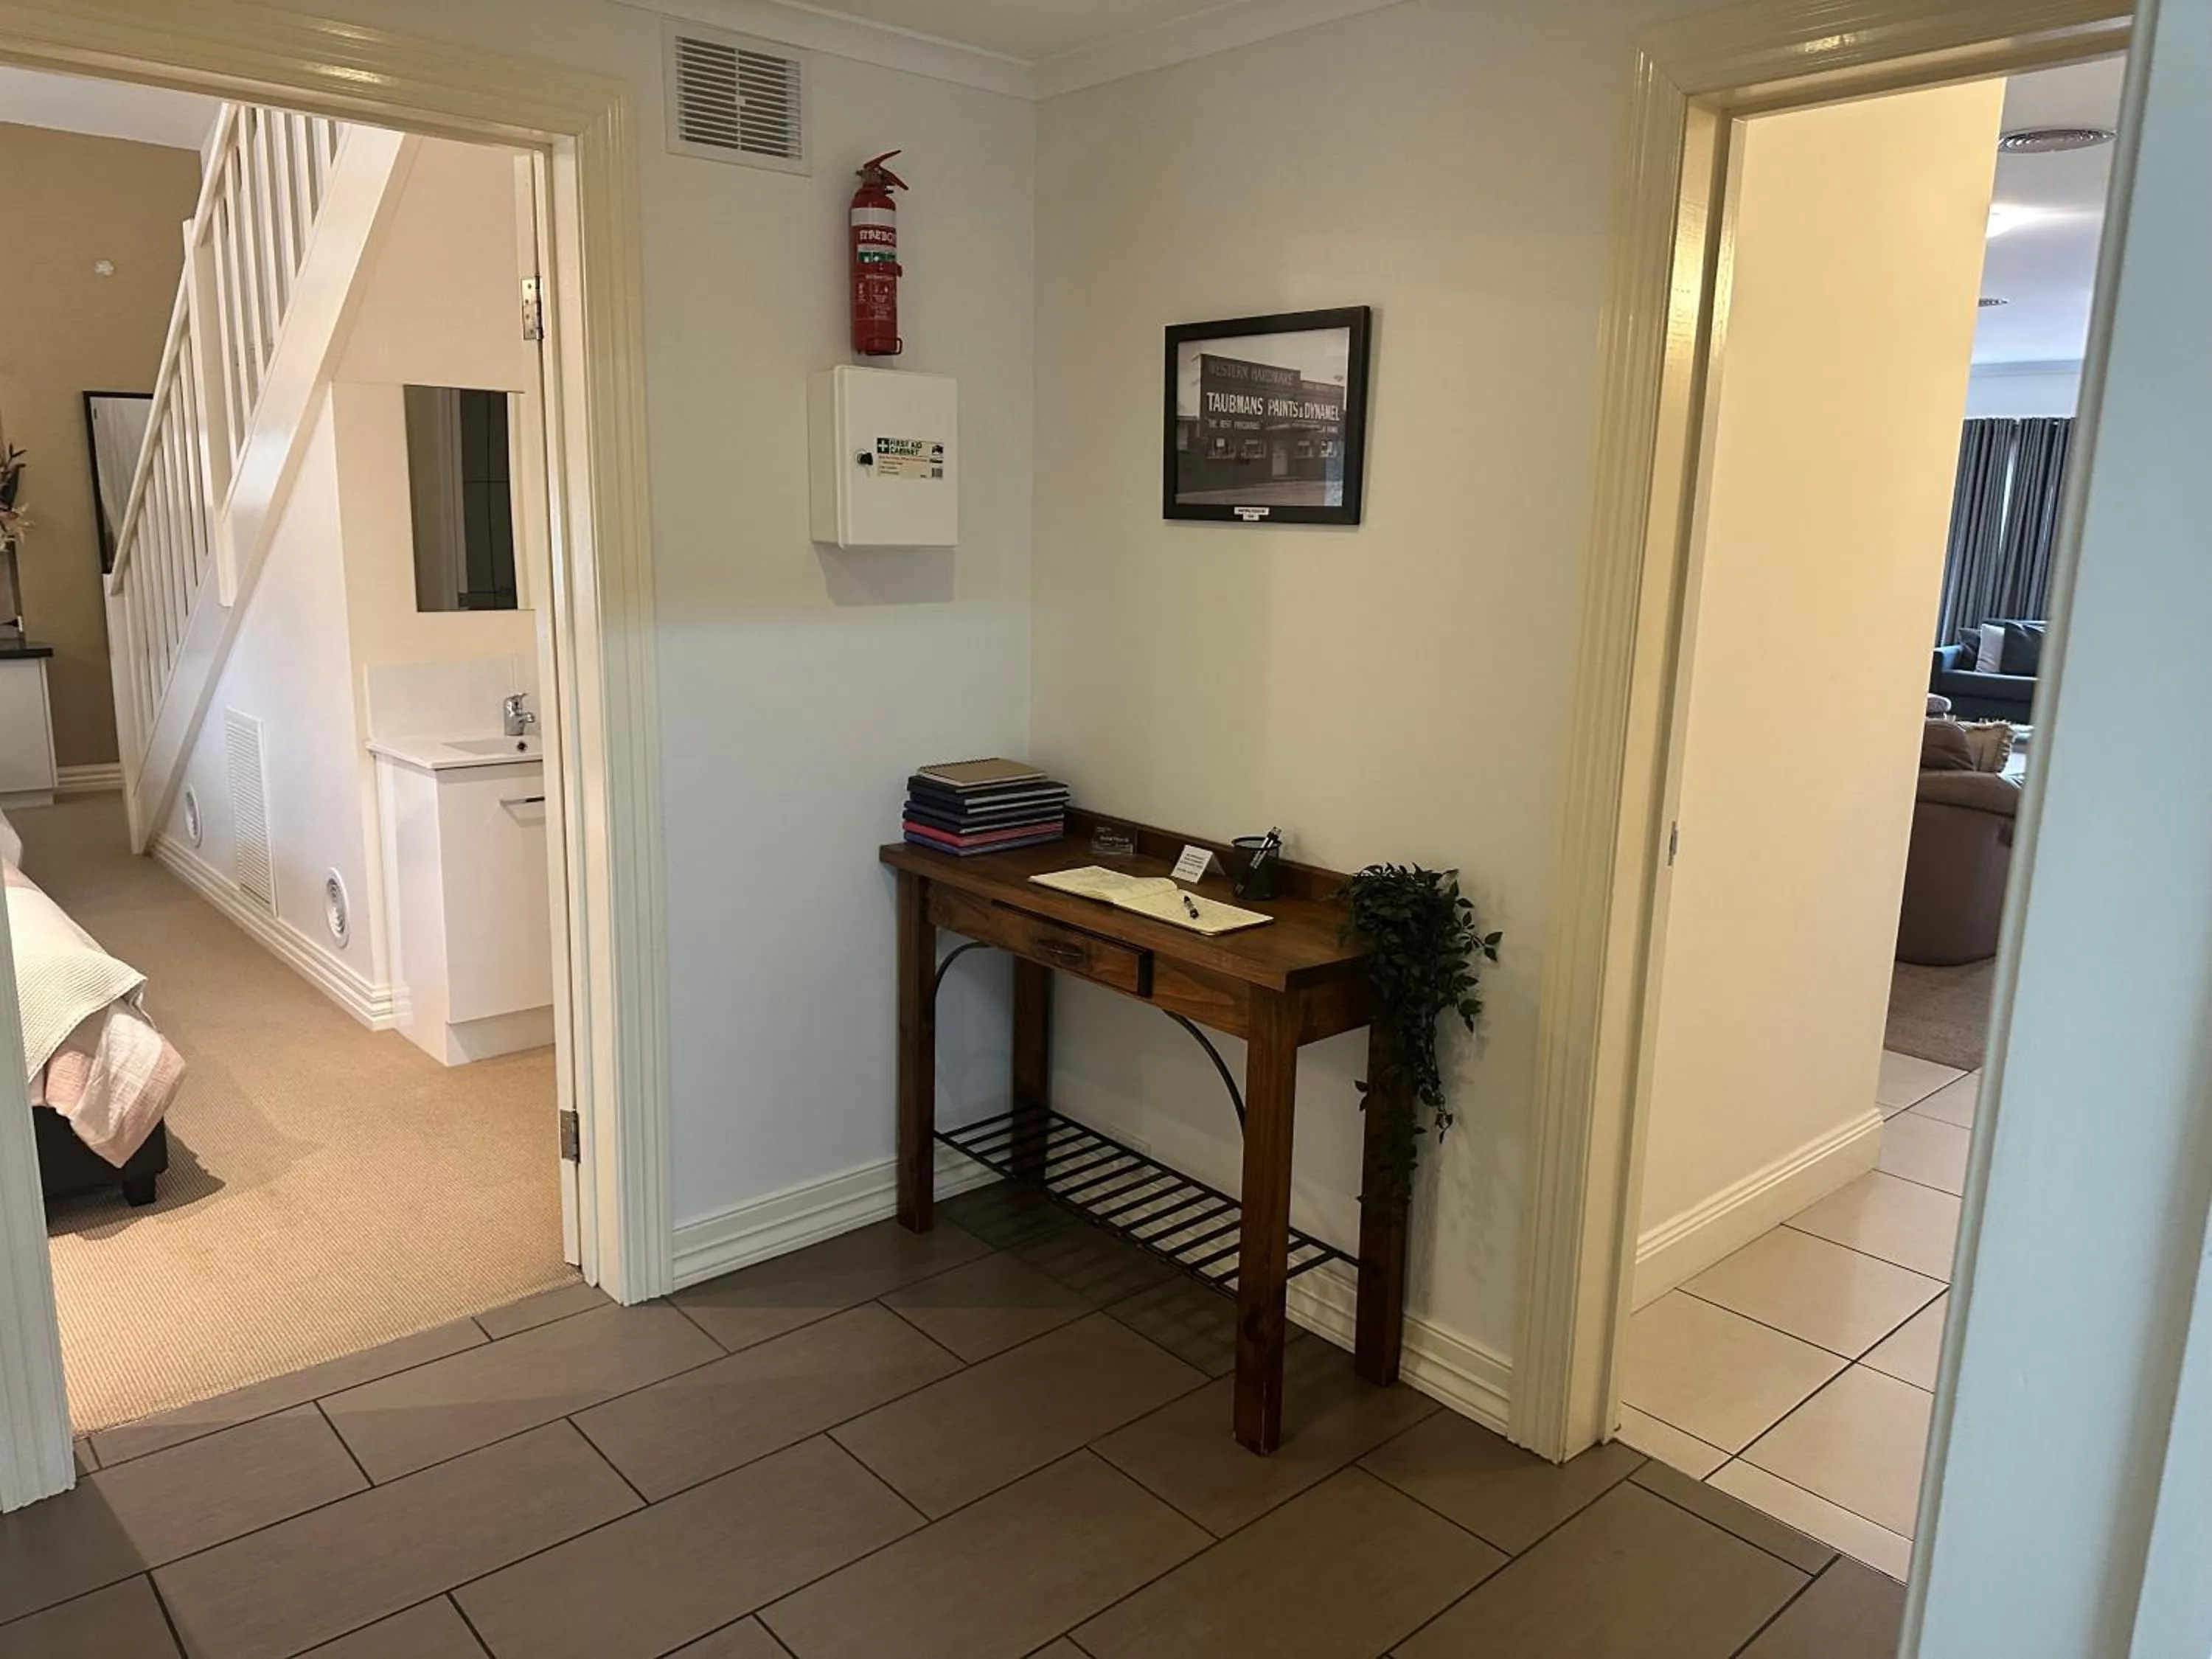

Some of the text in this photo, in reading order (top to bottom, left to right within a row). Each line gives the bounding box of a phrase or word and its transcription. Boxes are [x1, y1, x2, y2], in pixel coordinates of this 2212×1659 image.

[1206, 392, 1263, 416] TAUBMANS
[1267, 398, 1299, 418] PAINTS
[1304, 402, 1340, 421] DYNAMEL
[890, 439, 922, 448] FIRST AID
[890, 446, 919, 456] CABINET
